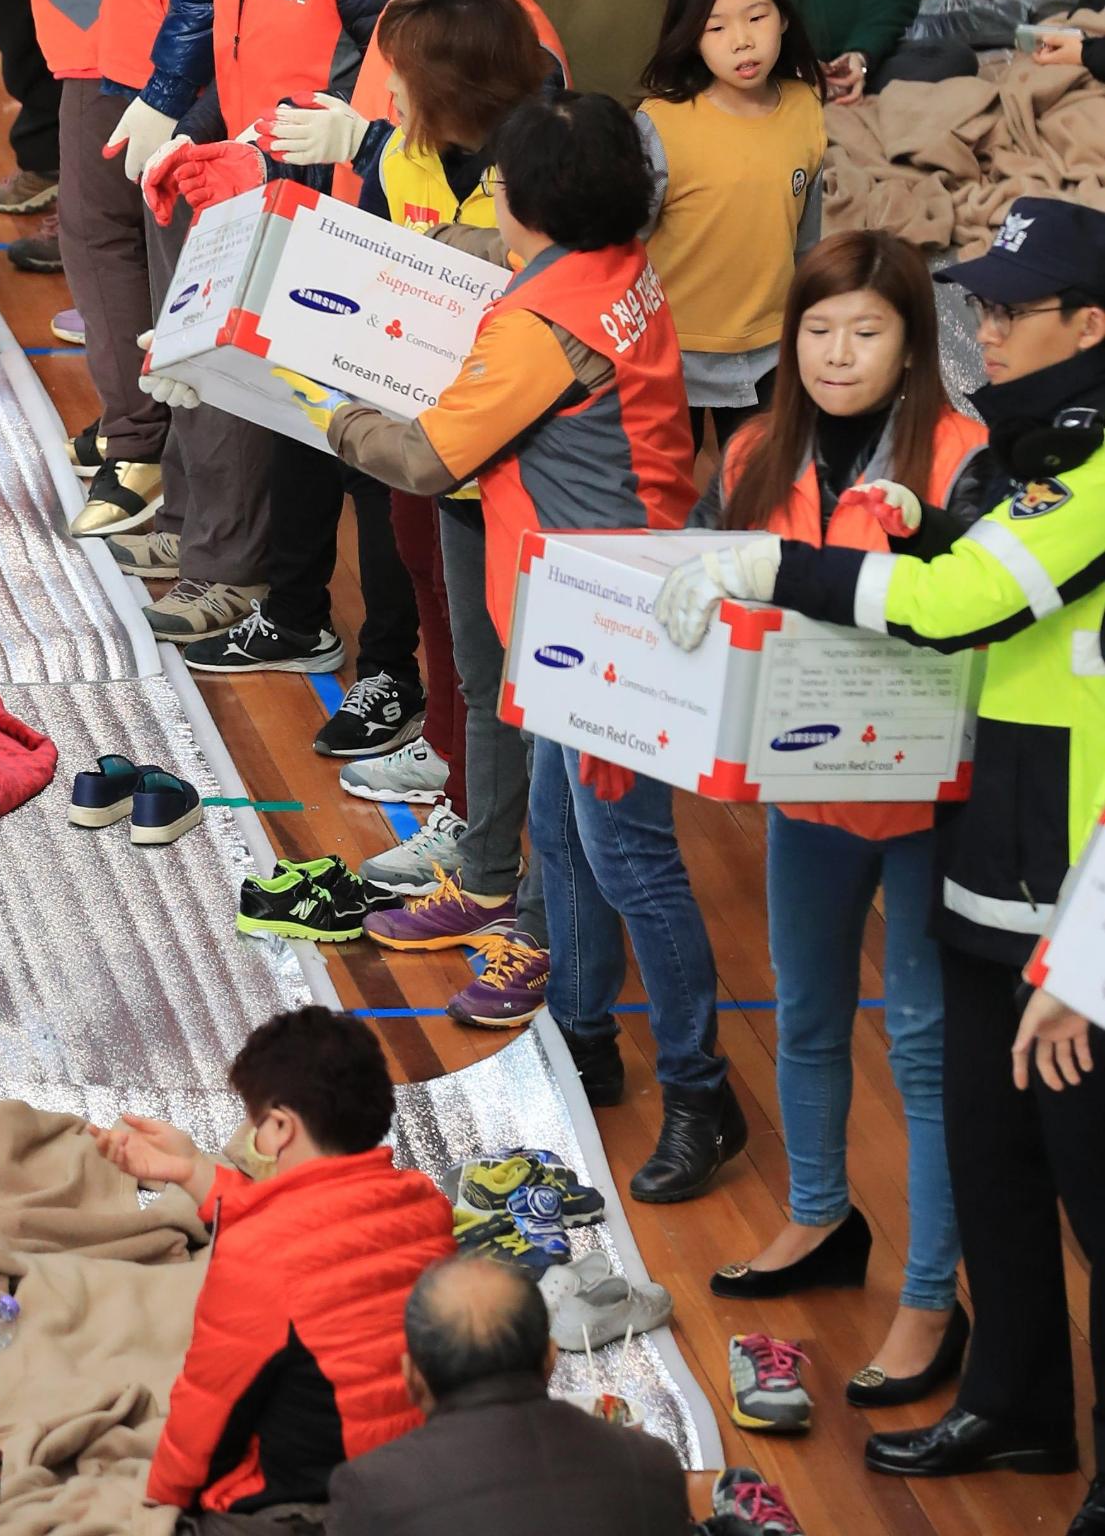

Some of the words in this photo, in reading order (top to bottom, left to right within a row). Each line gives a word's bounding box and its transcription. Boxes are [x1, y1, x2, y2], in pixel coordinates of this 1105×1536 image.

[319, 216, 434, 276] Humanitarian
[438, 265, 488, 302] Relief
[376, 269, 445, 308] Supported
[447, 298, 466, 319] By
[297, 287, 352, 315] SAMSUNG
[366, 313, 380, 328] &
[405, 332, 458, 363] Community
[599, 288, 648, 354] 오천읍
[331, 353, 382, 384] Korean
[382, 373, 412, 396] Red
[412, 386, 437, 407] Cro
[547, 563, 633, 609] Humanitarian
[593, 612, 644, 641] Supported
[645, 630, 660, 649] By
[539, 647, 580, 667] SAMSUNG
[618, 675, 658, 699] Community
[568, 711, 606, 738] Korean
[606, 724, 627, 746] Red
[627, 732, 657, 757] Cross
